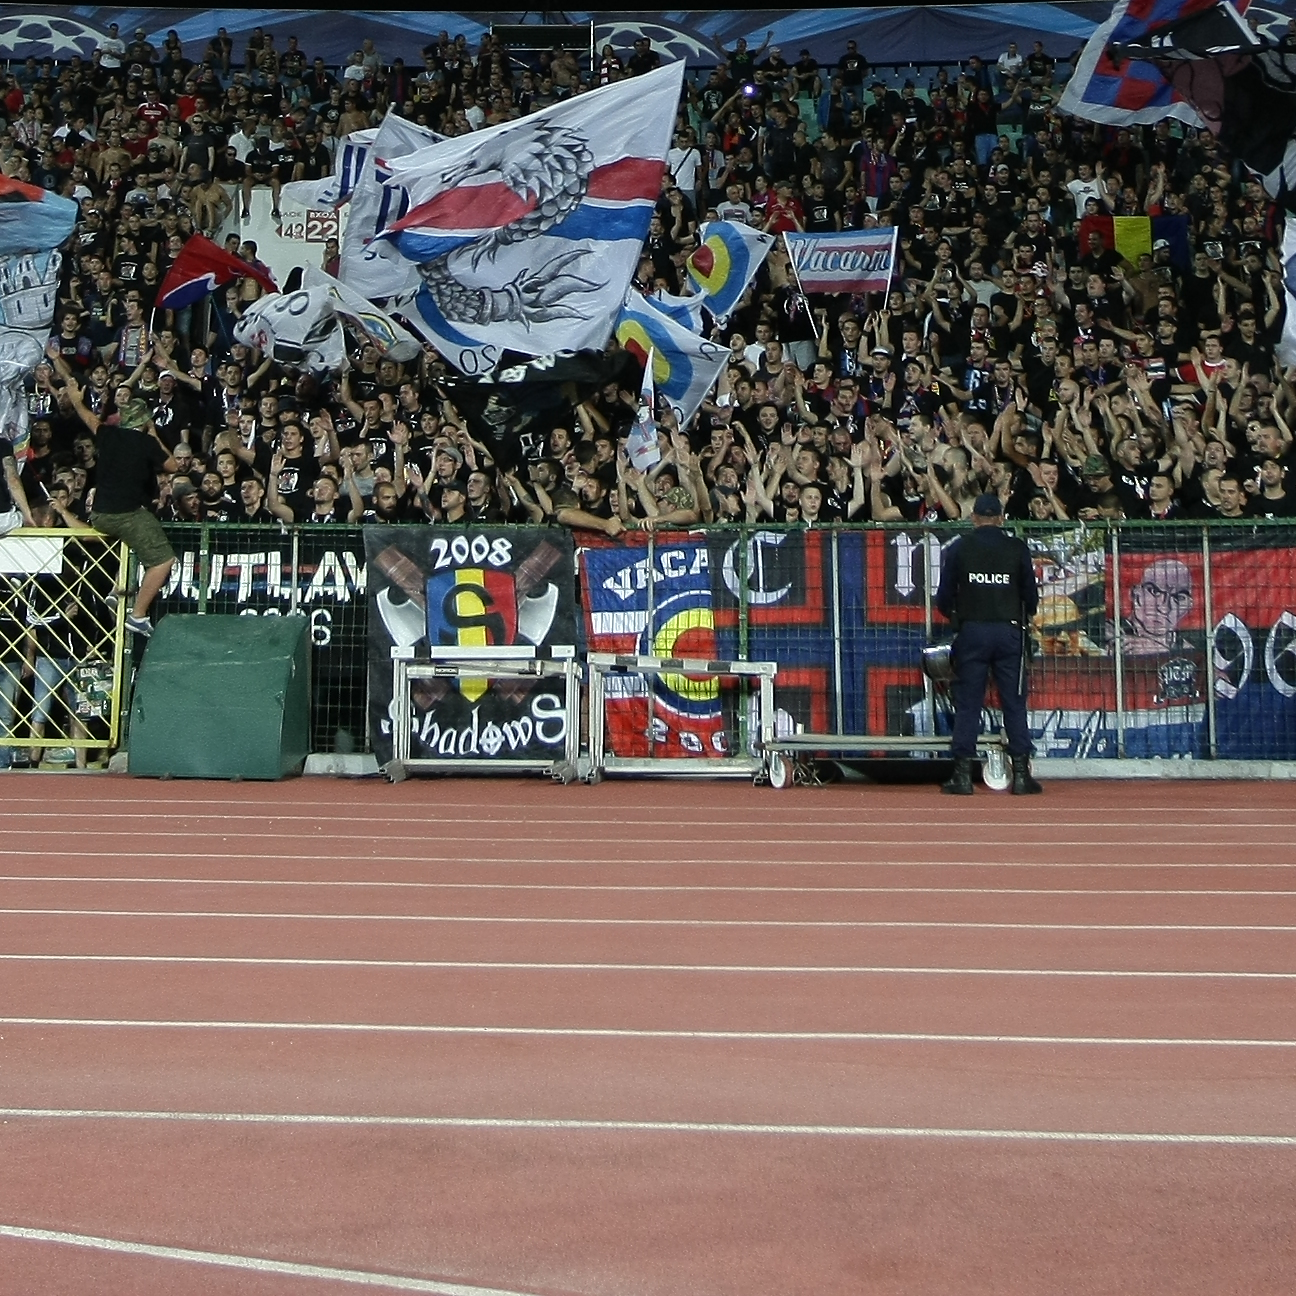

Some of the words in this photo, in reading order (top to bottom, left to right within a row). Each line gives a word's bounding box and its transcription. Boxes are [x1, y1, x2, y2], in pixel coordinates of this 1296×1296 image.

[307, 220, 338, 240] 22
[430, 534, 513, 570] 2008
[968, 572, 1010, 585] POLICE
